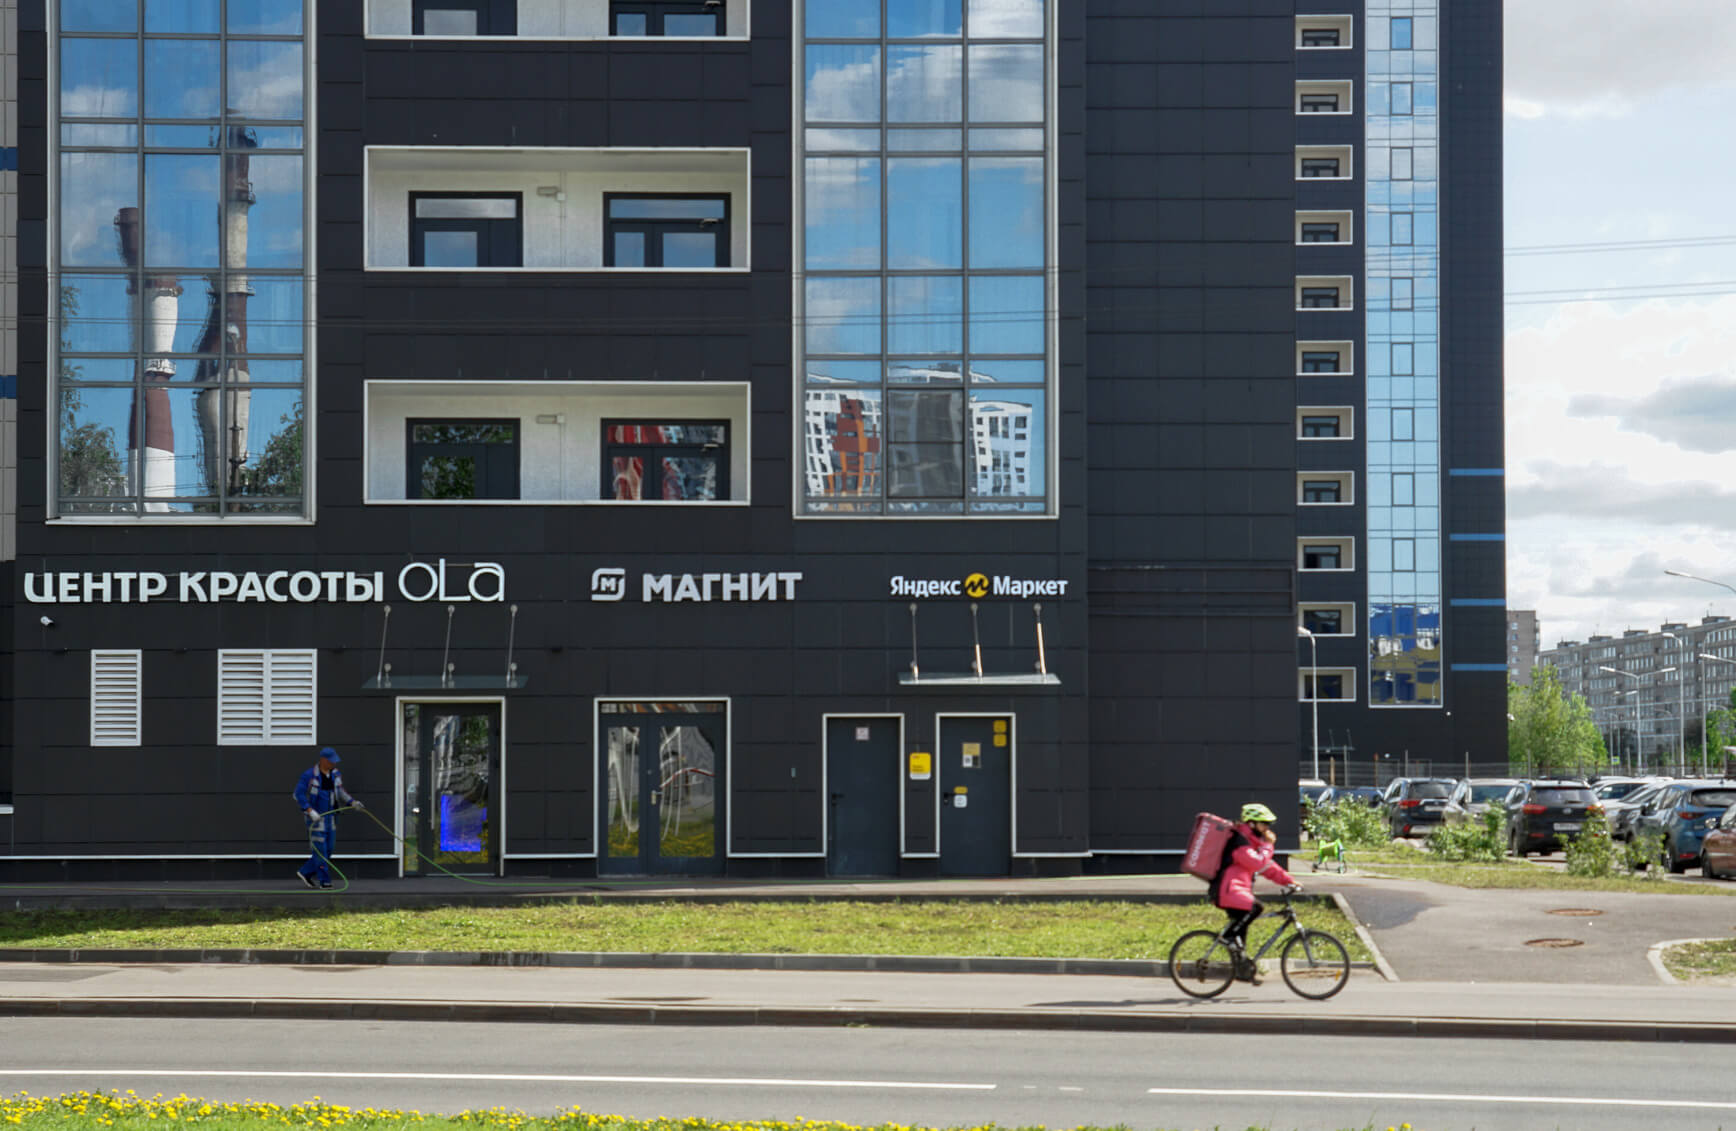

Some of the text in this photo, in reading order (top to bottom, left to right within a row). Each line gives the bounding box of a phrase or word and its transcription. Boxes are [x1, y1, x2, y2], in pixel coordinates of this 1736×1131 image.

[24, 572, 168, 603] ЦЕНТР
[180, 571, 384, 602] КРАСОТЫ
[643, 573, 803, 602] МАГНИТ
[890, 575, 962, 598] Яндекс
[993, 575, 1069, 599] Маркет
